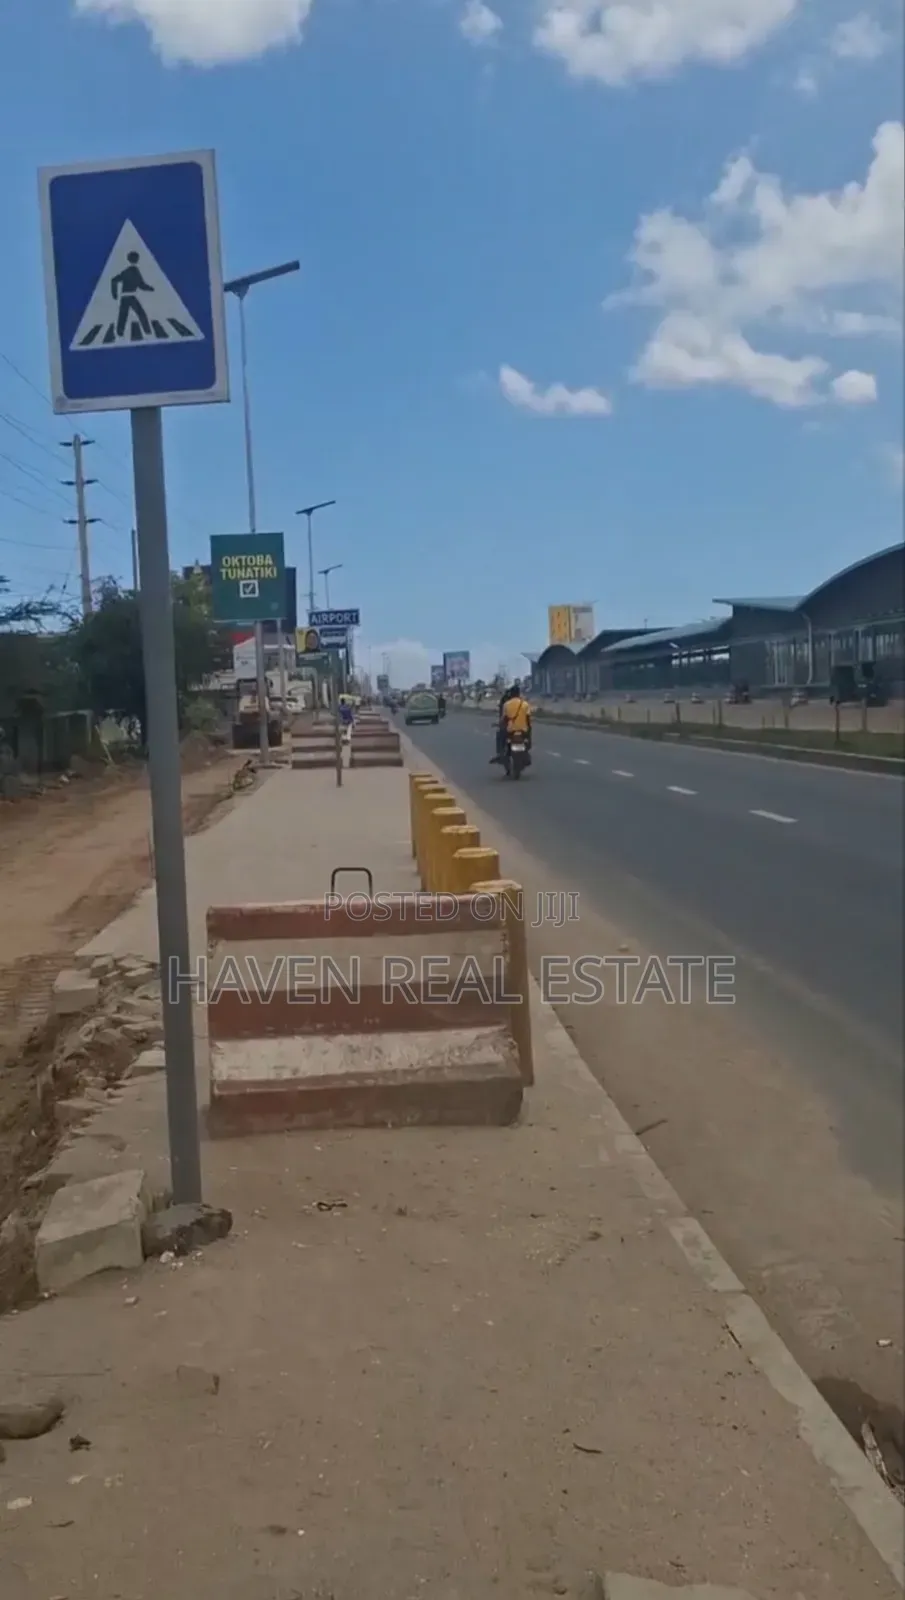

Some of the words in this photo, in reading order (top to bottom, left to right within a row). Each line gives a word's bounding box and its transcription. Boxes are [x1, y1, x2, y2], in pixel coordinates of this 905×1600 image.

[222, 554, 273, 567] OKTOBA
[220, 566, 277, 580] TUNATIKI
[311, 611, 358, 624] AIRPORT
